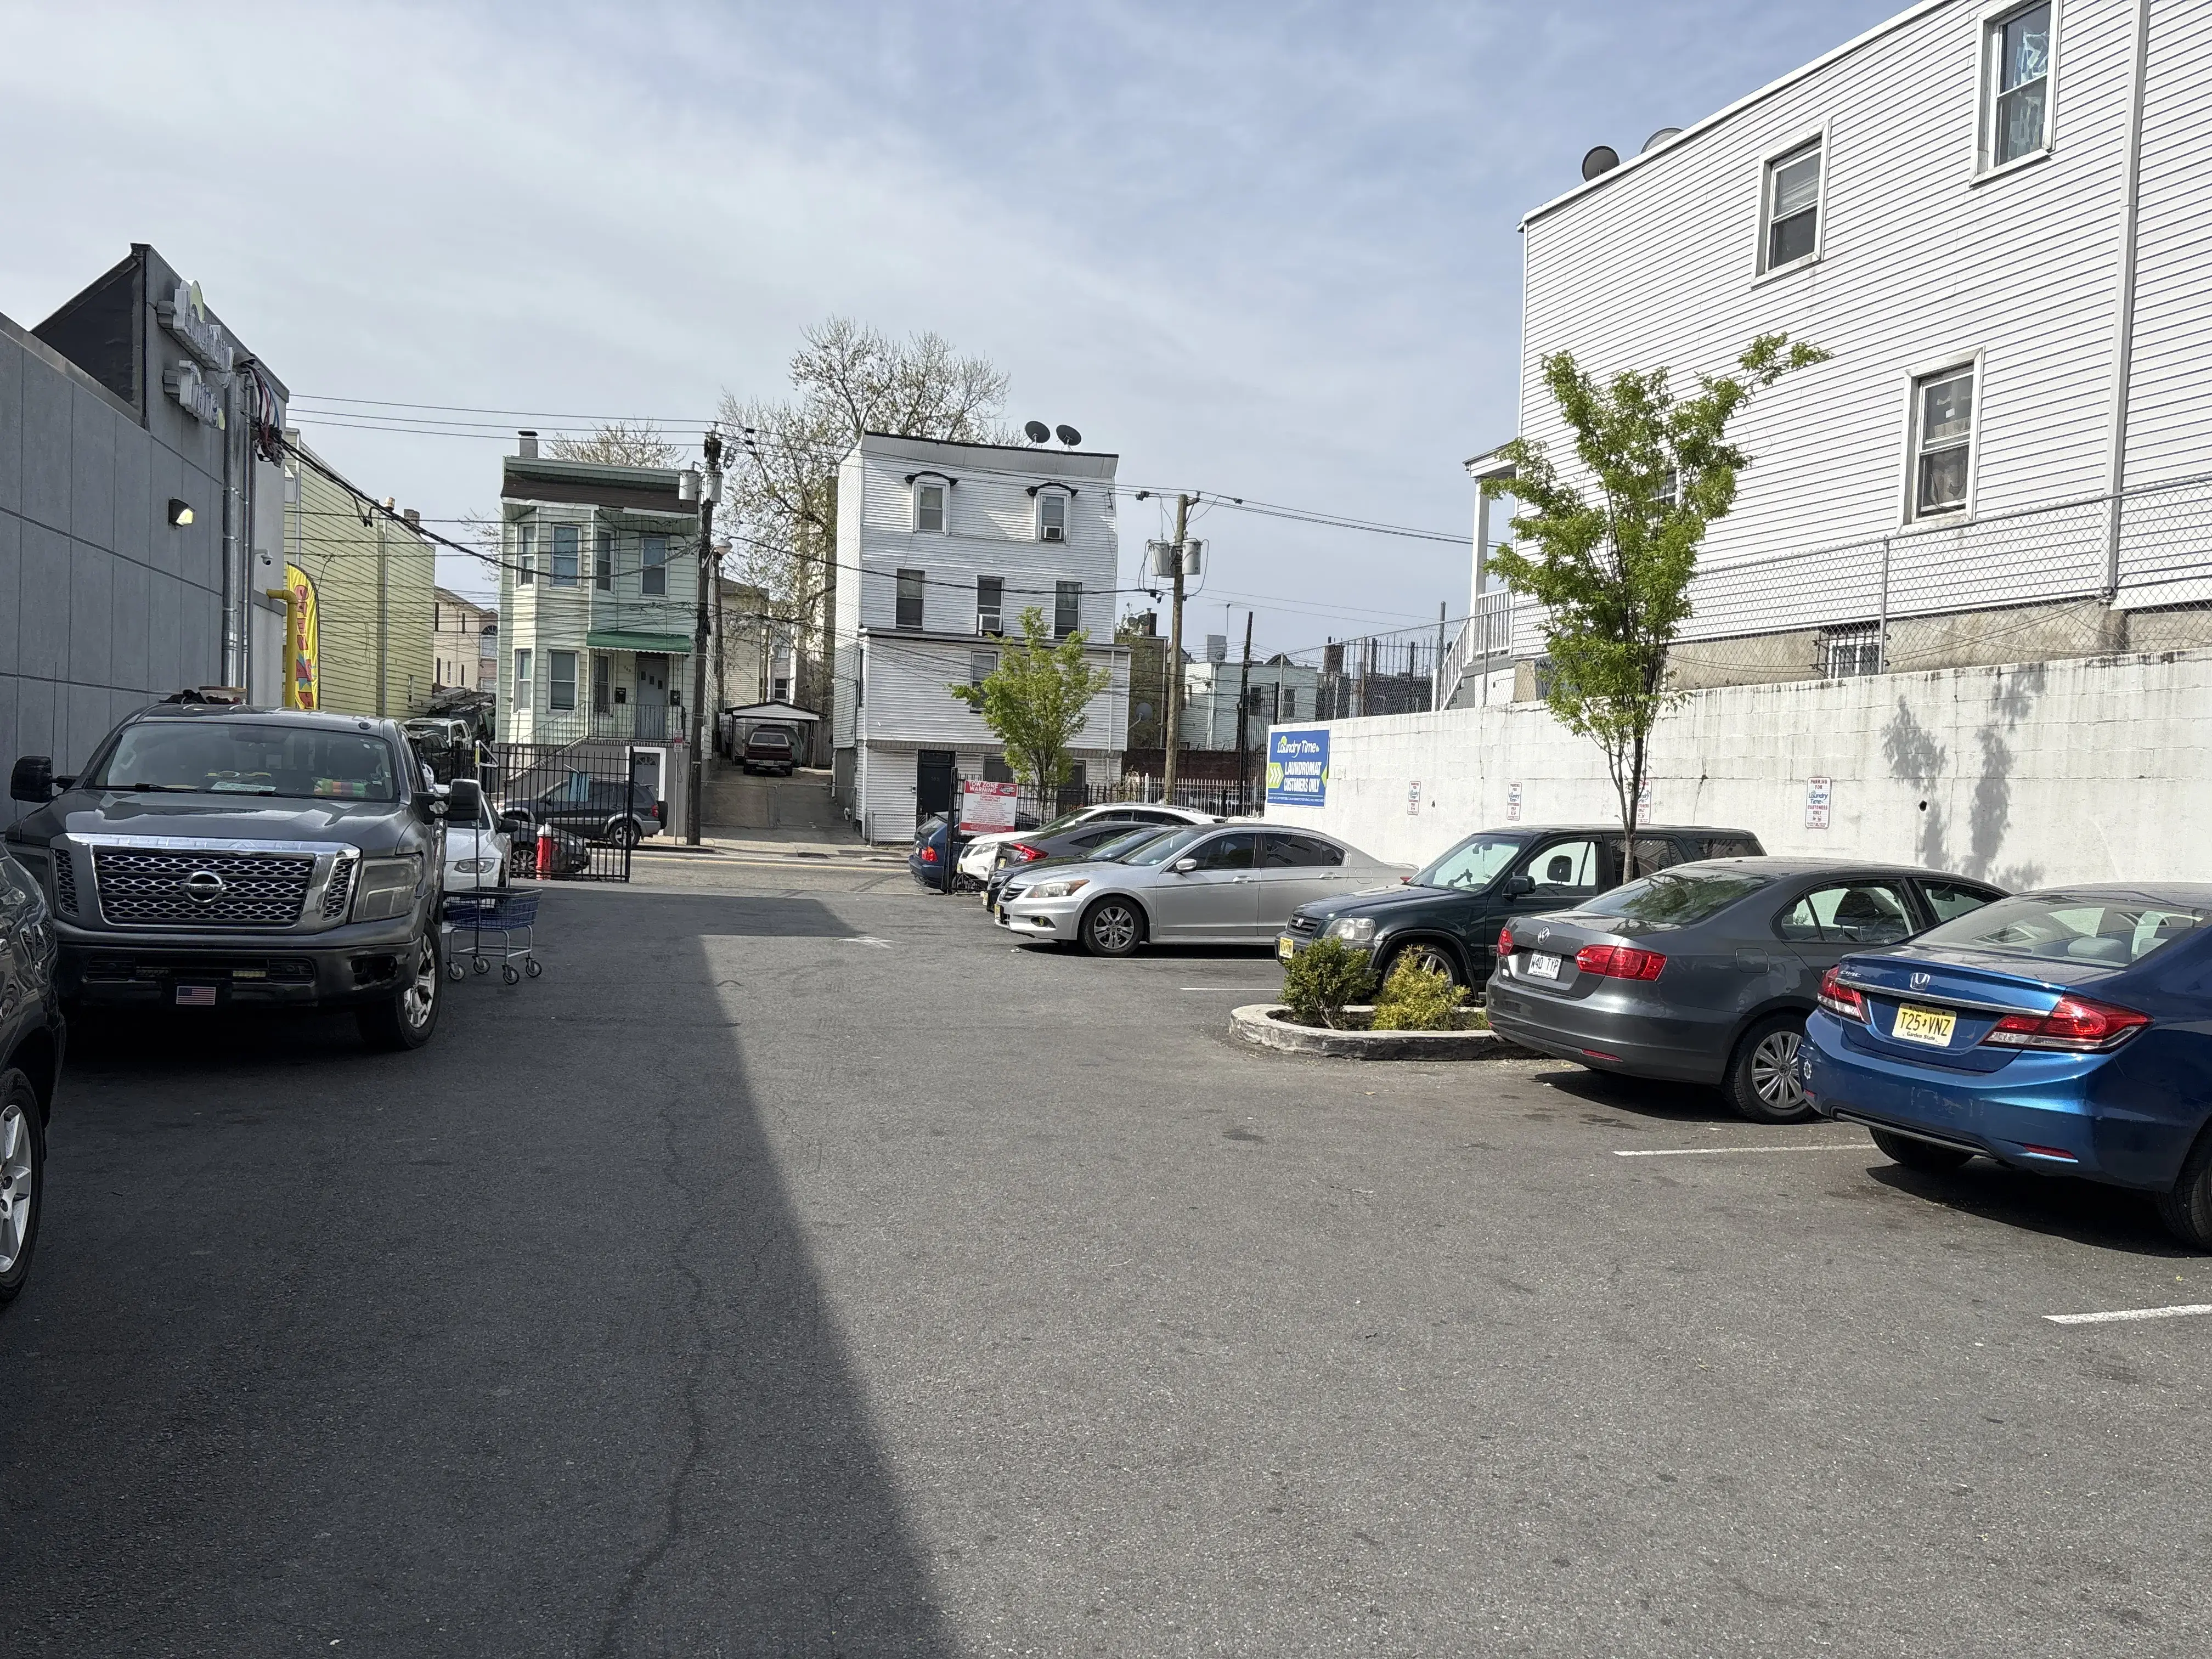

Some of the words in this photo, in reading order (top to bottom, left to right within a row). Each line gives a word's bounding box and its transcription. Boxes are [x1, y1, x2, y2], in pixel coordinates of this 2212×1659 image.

[1277, 740, 1301, 758] Laundry
[1301, 740, 1317, 753] Time
[1284, 761, 1322, 776] LAUNDROMAT
[1283, 777, 1308, 793] CUSTOMERS
[1308, 778, 1321, 793] ONLY
[1808, 792, 1829, 801] Laundry
[1546, 958, 1559, 973] TYR
[1900, 1012, 1922, 1031] T25
[1928, 1016, 1951, 1037] VNZ
